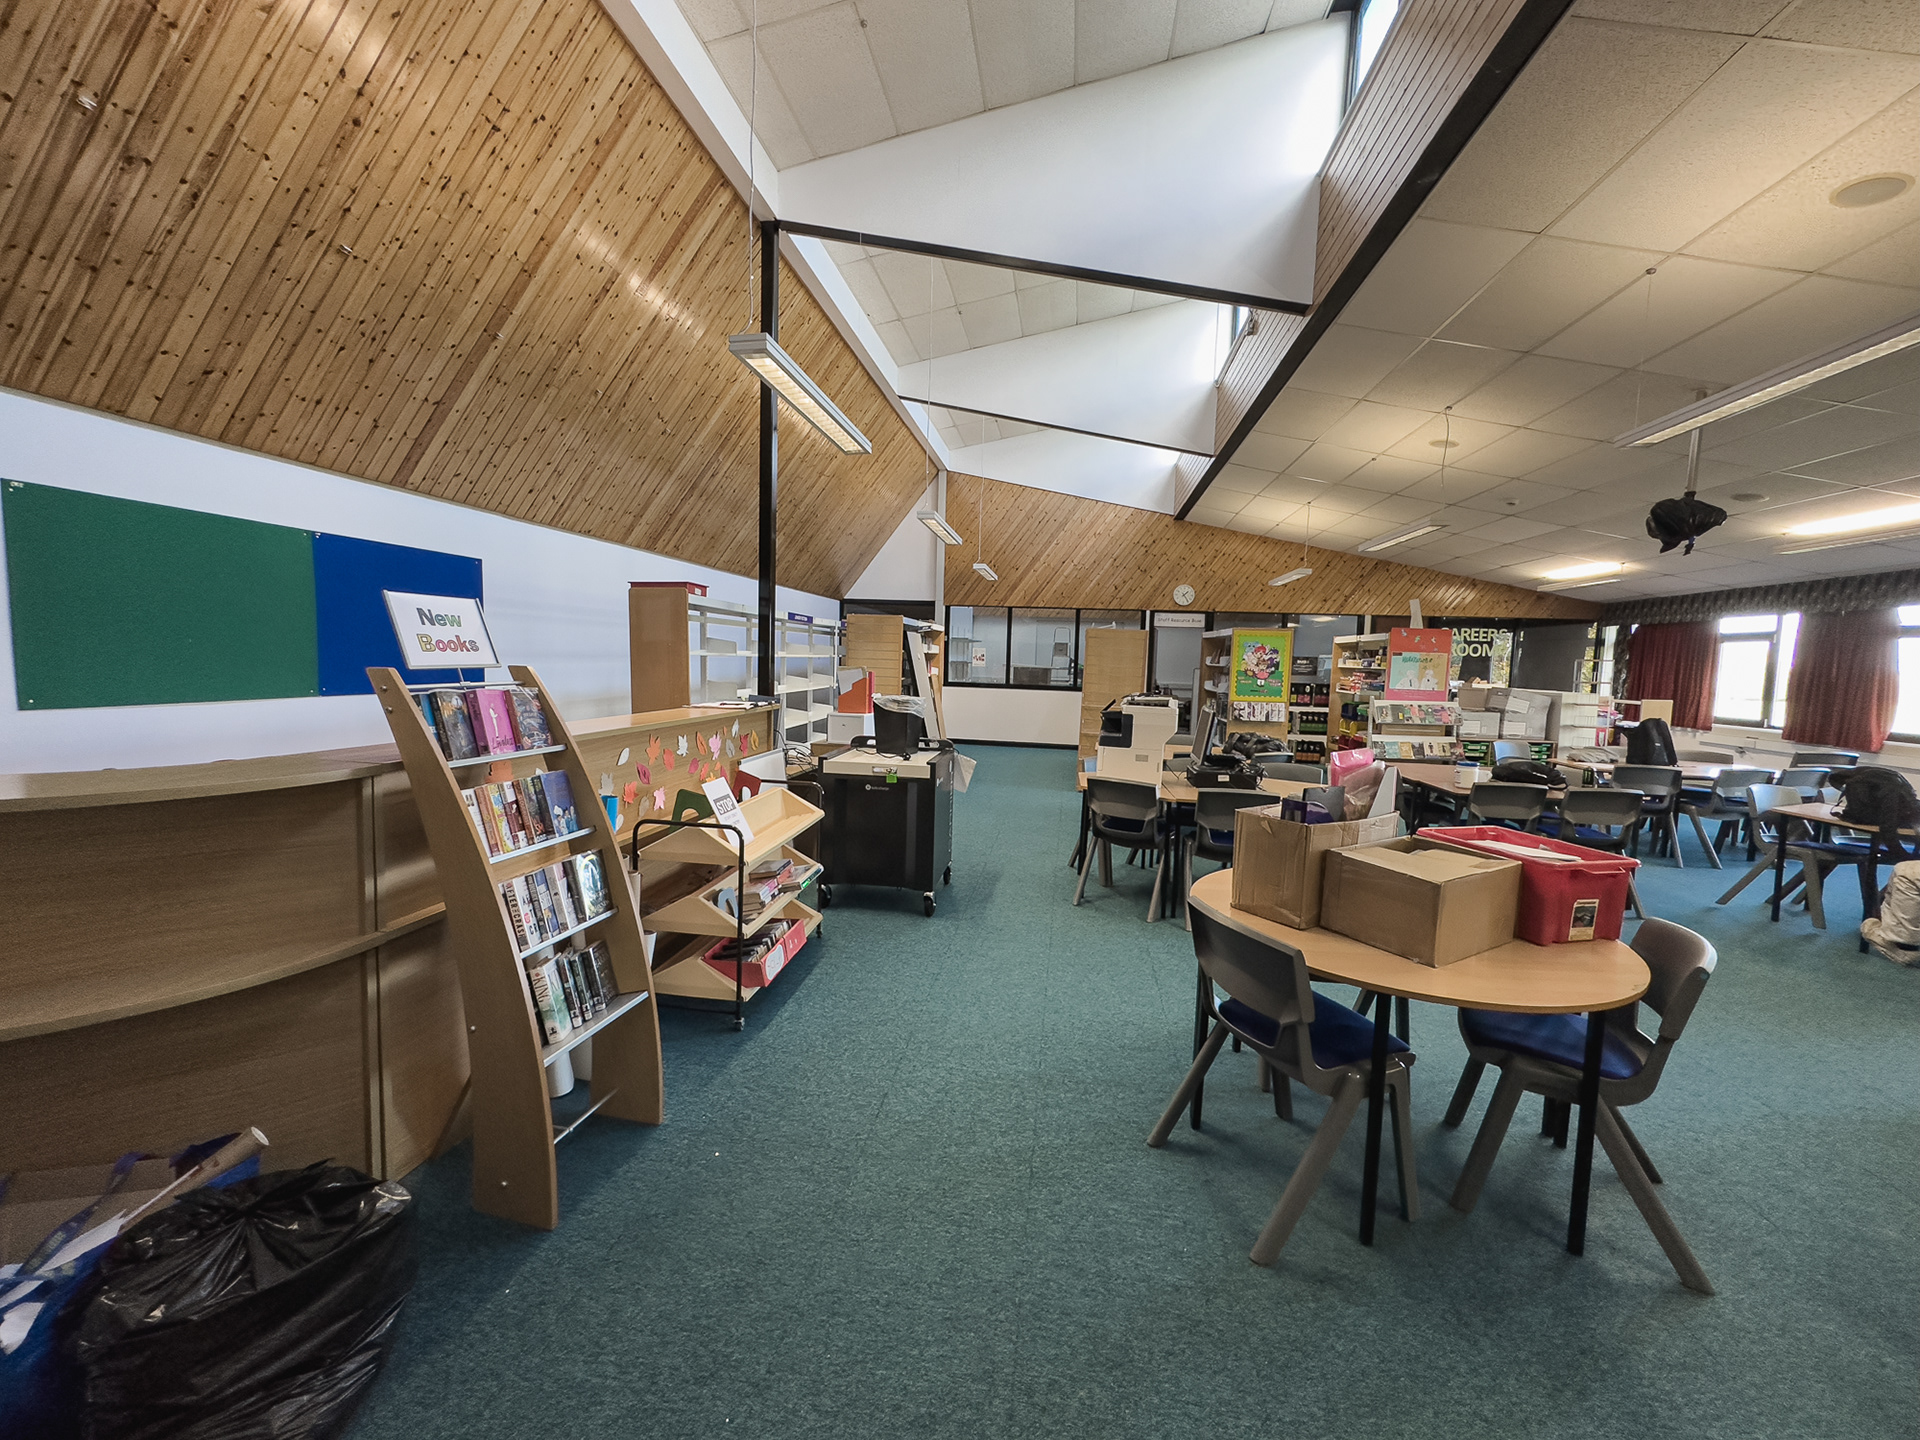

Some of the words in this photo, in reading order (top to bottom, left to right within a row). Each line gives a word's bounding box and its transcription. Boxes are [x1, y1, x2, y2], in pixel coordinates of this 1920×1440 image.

[415, 607, 462, 627] New
[415, 633, 480, 652] Books
[716, 797, 733, 814] STOP
[532, 975, 549, 1003] KING
